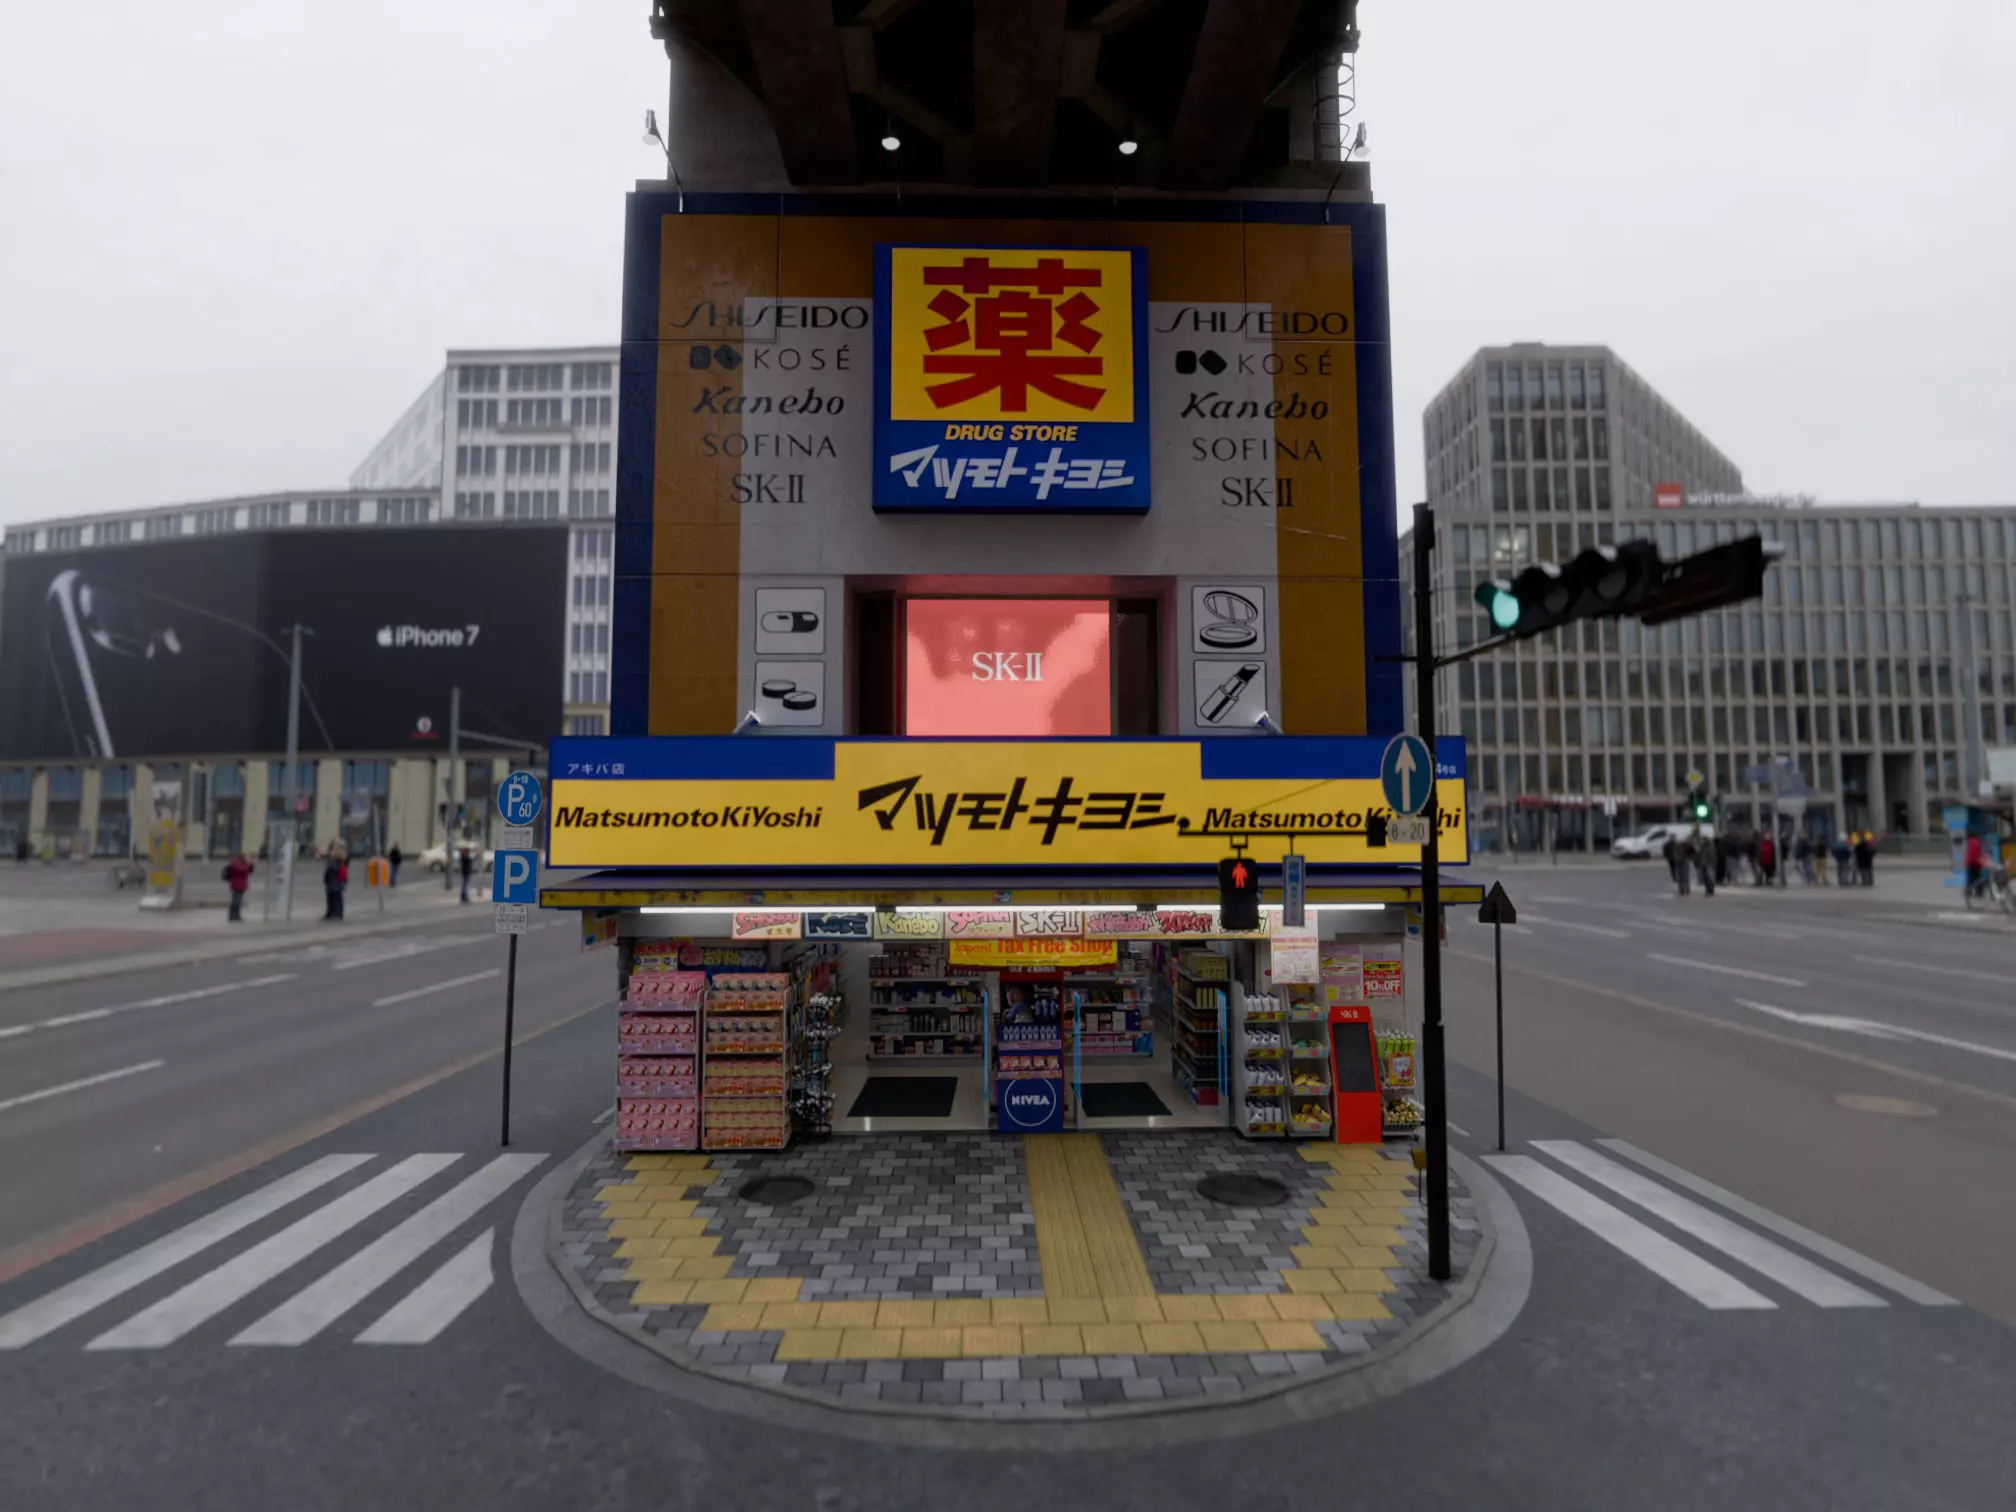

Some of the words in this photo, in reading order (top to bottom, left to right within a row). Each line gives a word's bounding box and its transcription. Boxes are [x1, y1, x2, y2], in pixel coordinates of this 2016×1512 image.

[669, 300, 869, 330] SHISEIDO
[1153, 306, 1350, 336] SHISEIDO
[922, 257, 1108, 412] 薬
[753, 343, 851, 371] KOSÉ
[1237, 349, 1333, 376] KOSÉ
[692, 386, 845, 416] Kanebo
[1180, 391, 1329, 420] Kanebo
[702, 433, 838, 459] SOFINA
[944, 423, 1005, 442] DRUG
[1009, 424, 1079, 443] STORE
[1191, 436, 1323, 462] SOFINA
[889, 443, 1135, 501] マツモトキヨシ
[729, 472, 809, 505] SK-II
[1220, 476, 1296, 508] SK-II
[395, 624, 464, 647] iPhone
[465, 623, 481, 647] 7
[971, 651, 1044, 683] SK-II
[507, 783, 526, 818] P
[518, 801, 533, 818] 60
[858, 774, 1177, 847] マツモトキヨシ
[503, 854, 531, 900] P
[878, 912, 940, 935] Kanebo
[1011, 1094, 1050, 1107] NIVEA
